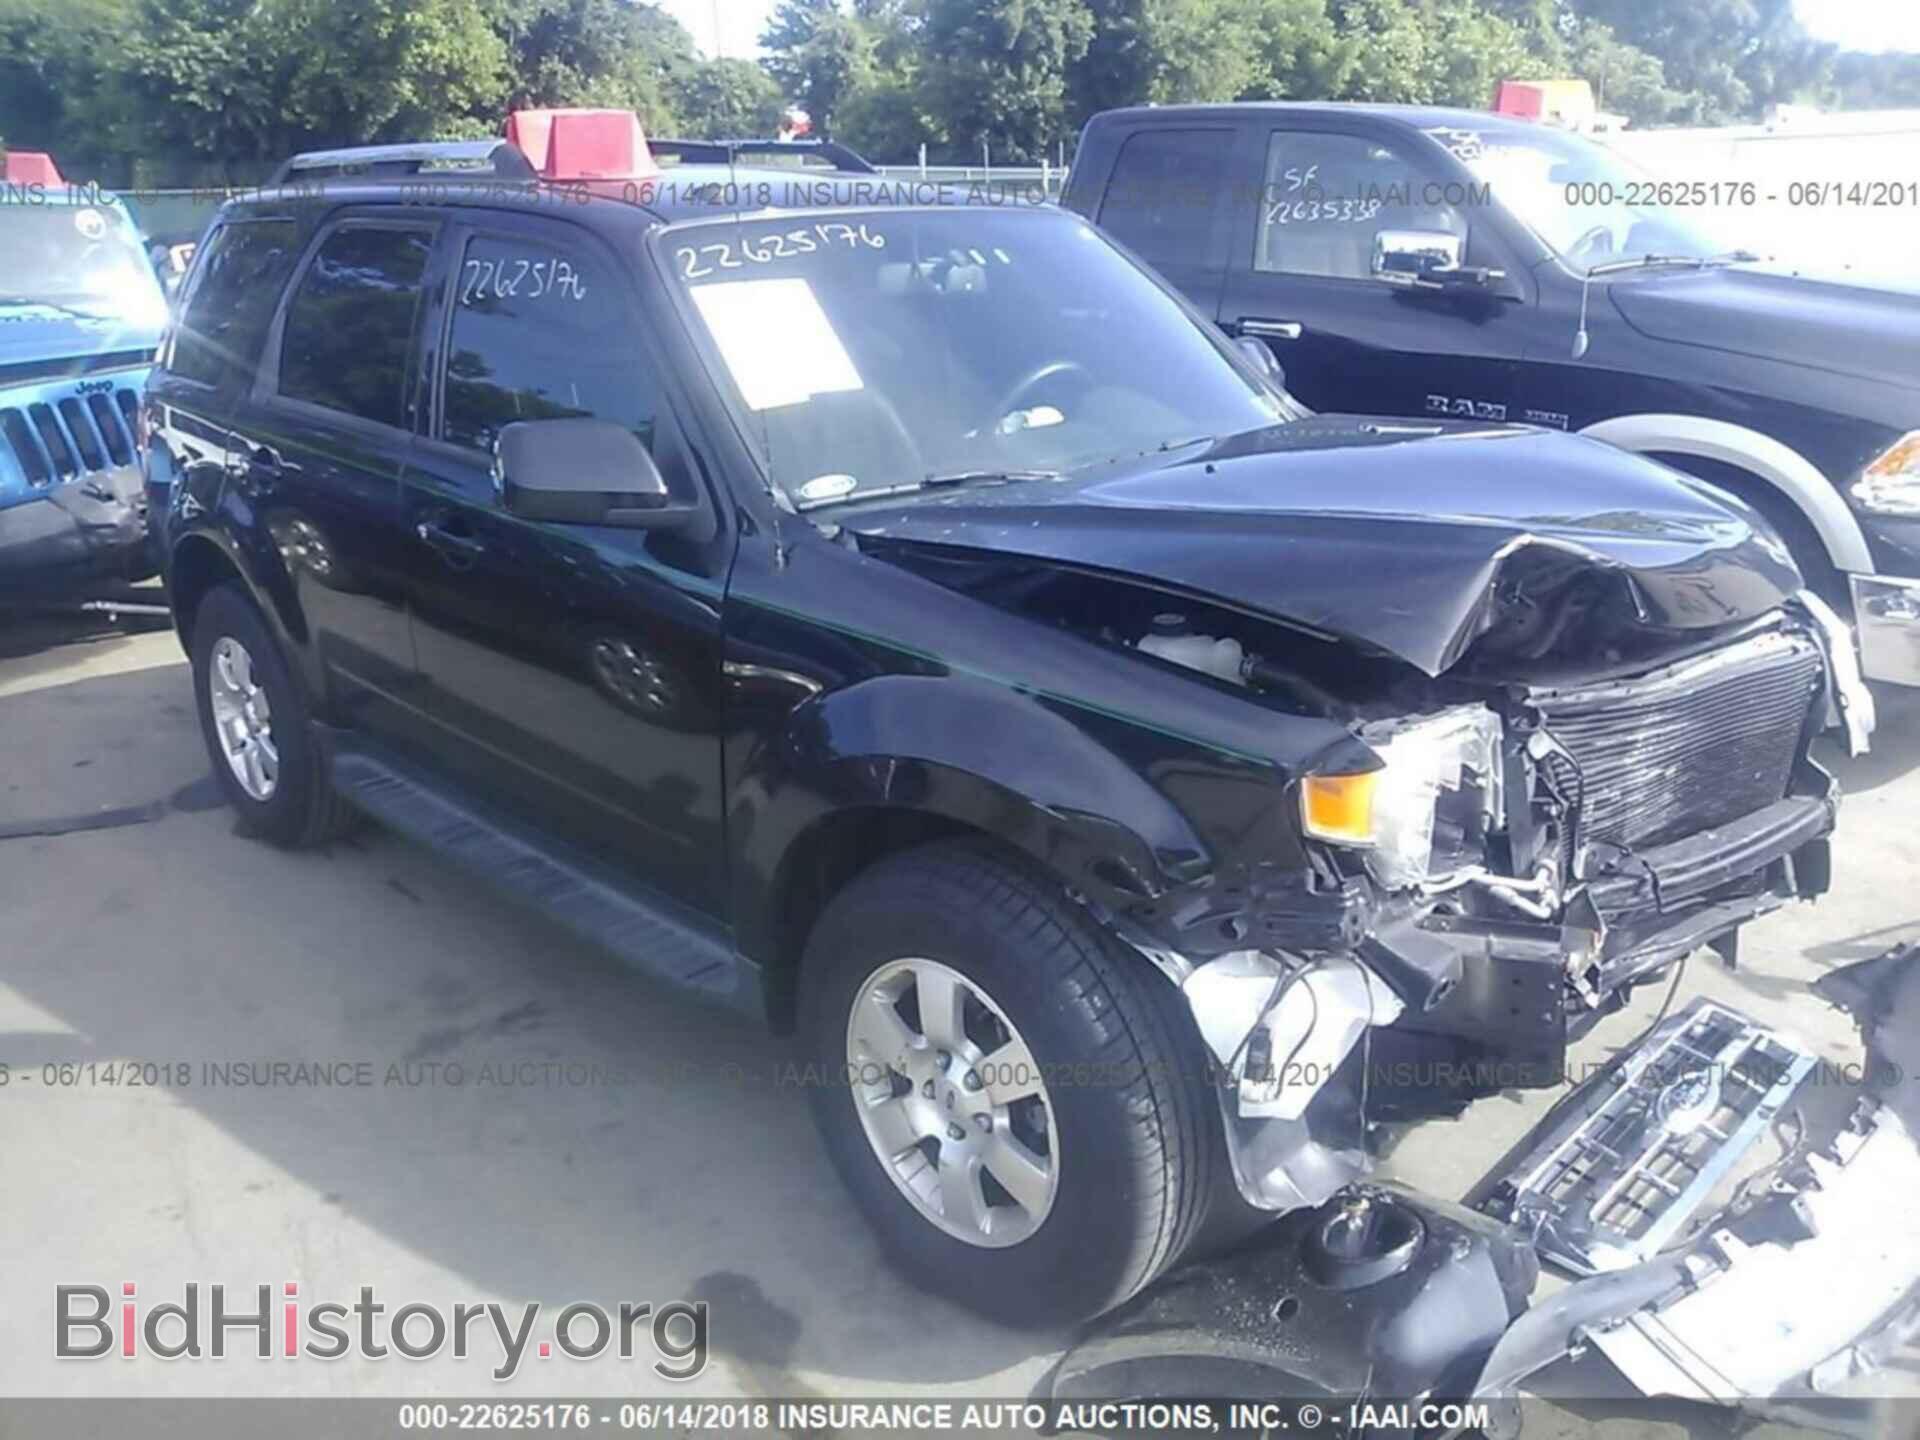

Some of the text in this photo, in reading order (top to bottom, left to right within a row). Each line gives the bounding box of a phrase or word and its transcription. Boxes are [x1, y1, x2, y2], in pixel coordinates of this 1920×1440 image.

[677, 224, 885, 280] 22625176
[75, 380, 114, 395] Jeep
[1425, 394, 1507, 421] RAM
